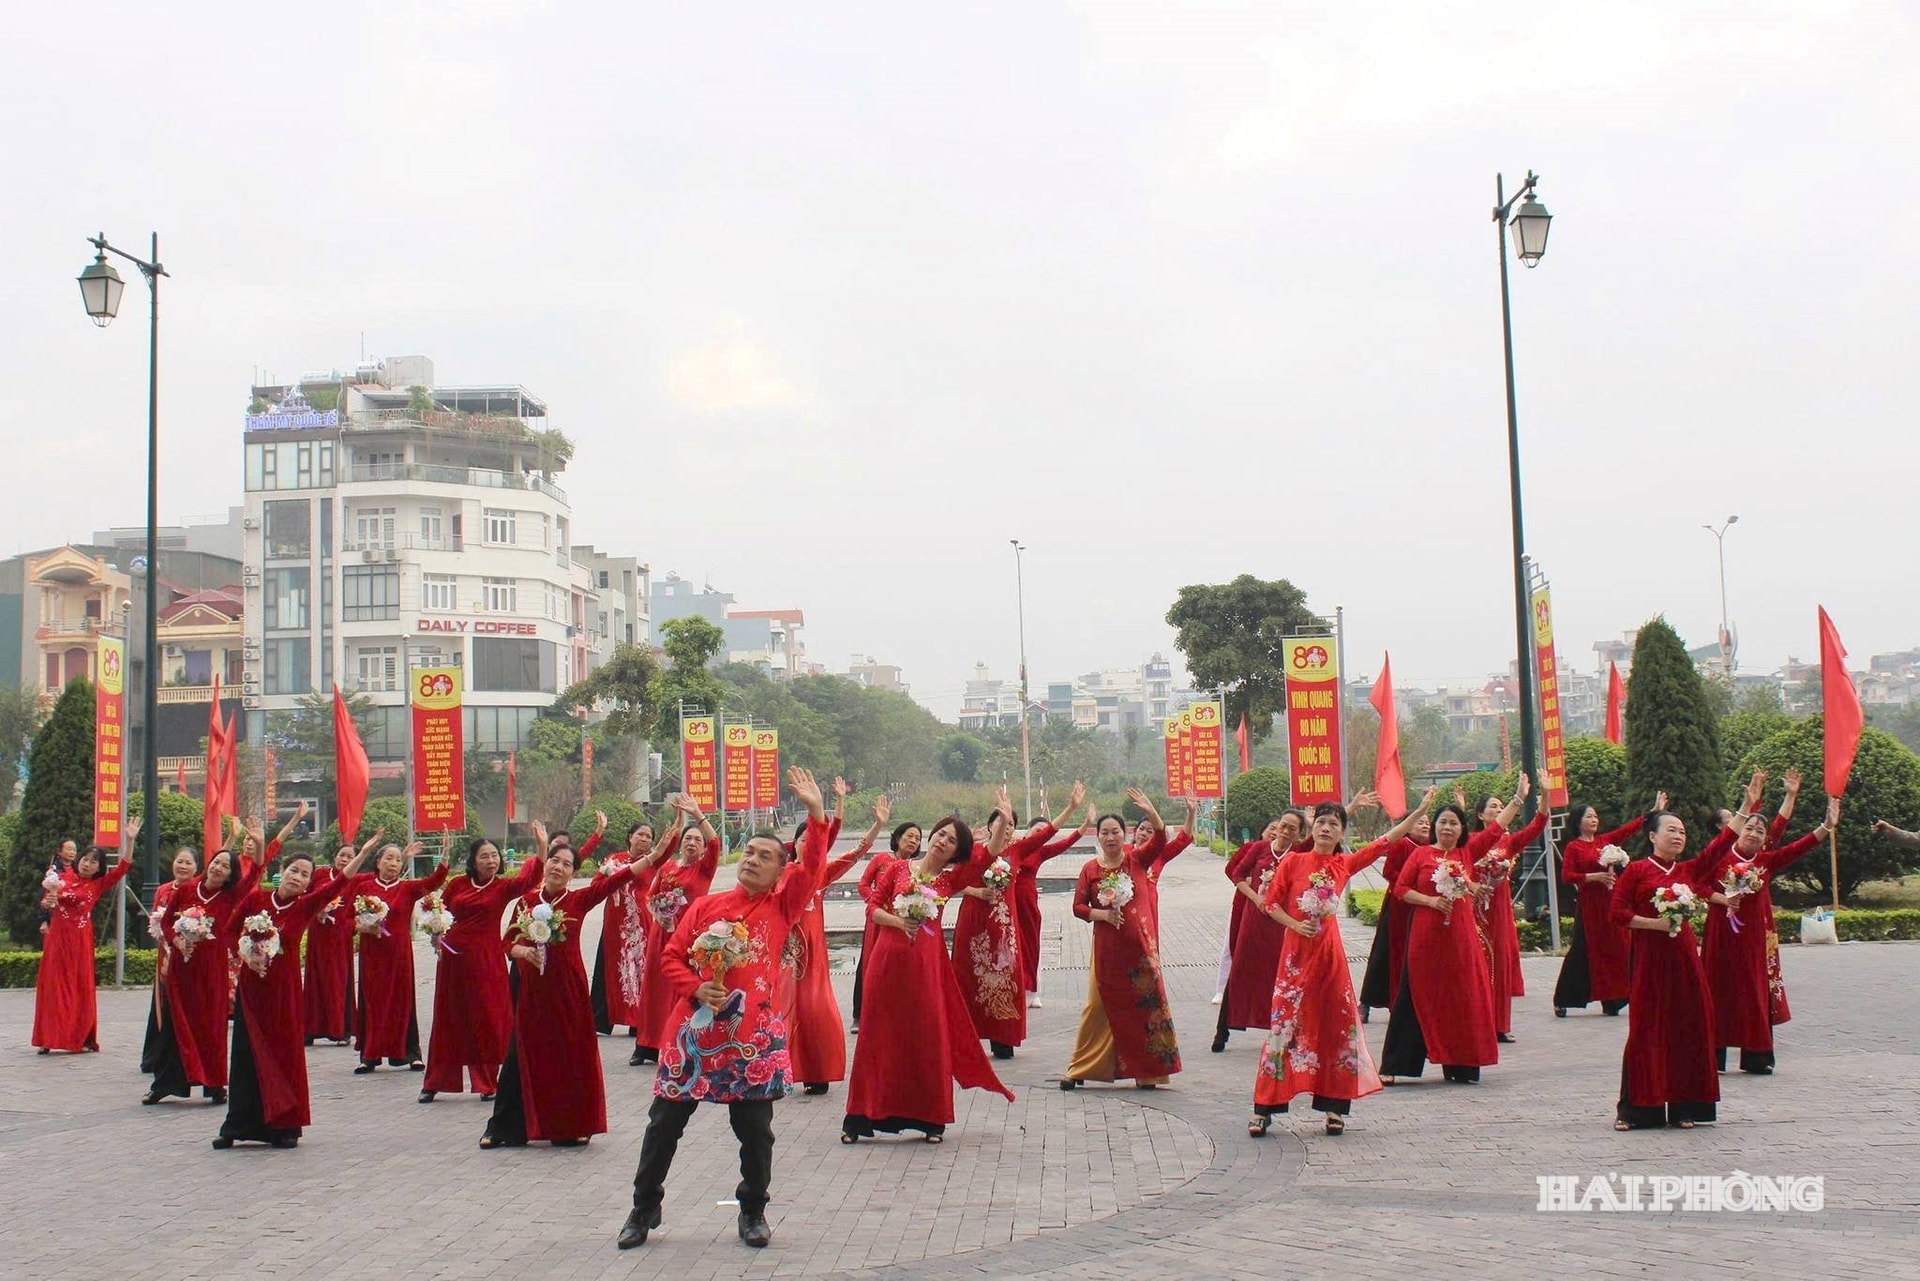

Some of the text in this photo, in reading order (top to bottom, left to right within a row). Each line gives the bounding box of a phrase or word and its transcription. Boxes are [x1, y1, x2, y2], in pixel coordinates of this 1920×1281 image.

[418, 620, 536, 634] DAILY COFFEE
[1293, 646, 1328, 669] 80
[420, 674, 454, 697] 80
[1292, 690, 1333, 710] VINH QUANG
[1300, 716, 1327, 736] 80 NĂM
[1299, 740, 1331, 768] QUỐC HỘI
[1299, 772, 1333, 796] VIỆT NAM!
